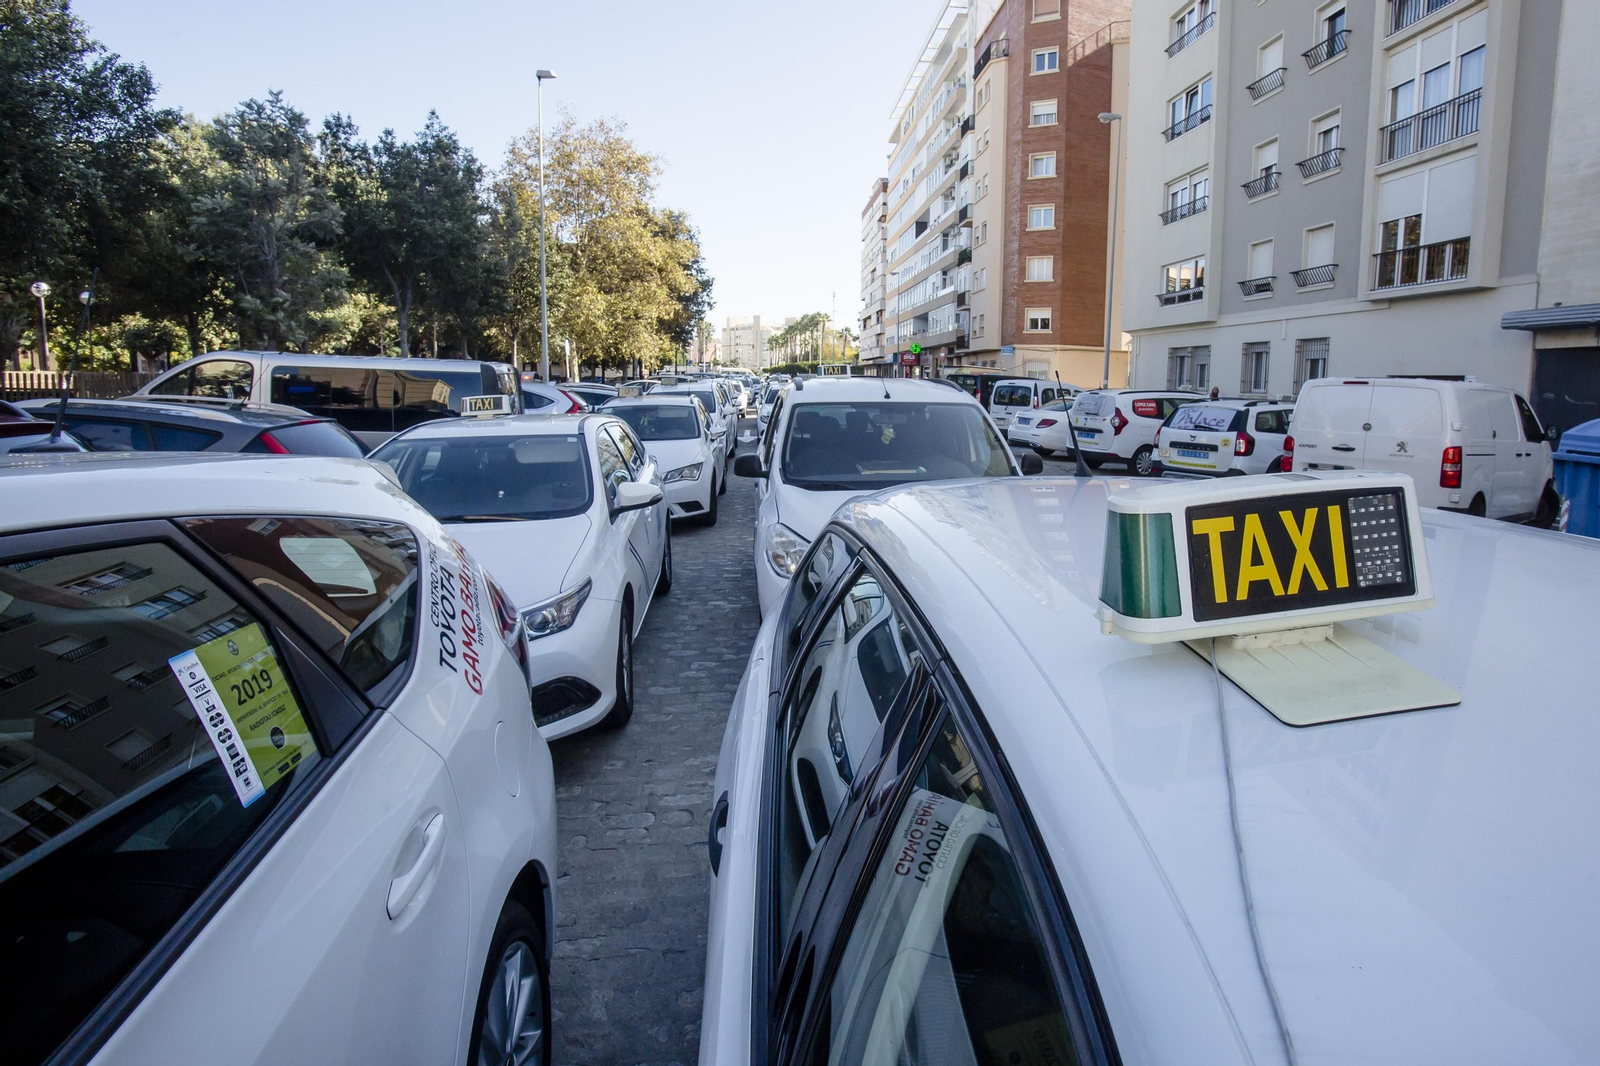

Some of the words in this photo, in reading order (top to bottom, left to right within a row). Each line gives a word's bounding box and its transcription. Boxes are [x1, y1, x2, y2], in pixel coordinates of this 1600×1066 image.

[823, 366, 842, 376] TAXI
[469, 398, 494, 411] TAXI
[1177, 412, 1225, 427] Palace
[1192, 505, 1350, 604] TAXI
[431, 571, 440, 628] CENTRO
[440, 565, 458, 674] TOYOTA
[461, 608, 483, 696] GAMO
[193, 683, 207, 694] VISA
[230, 668, 273, 707] 2019
